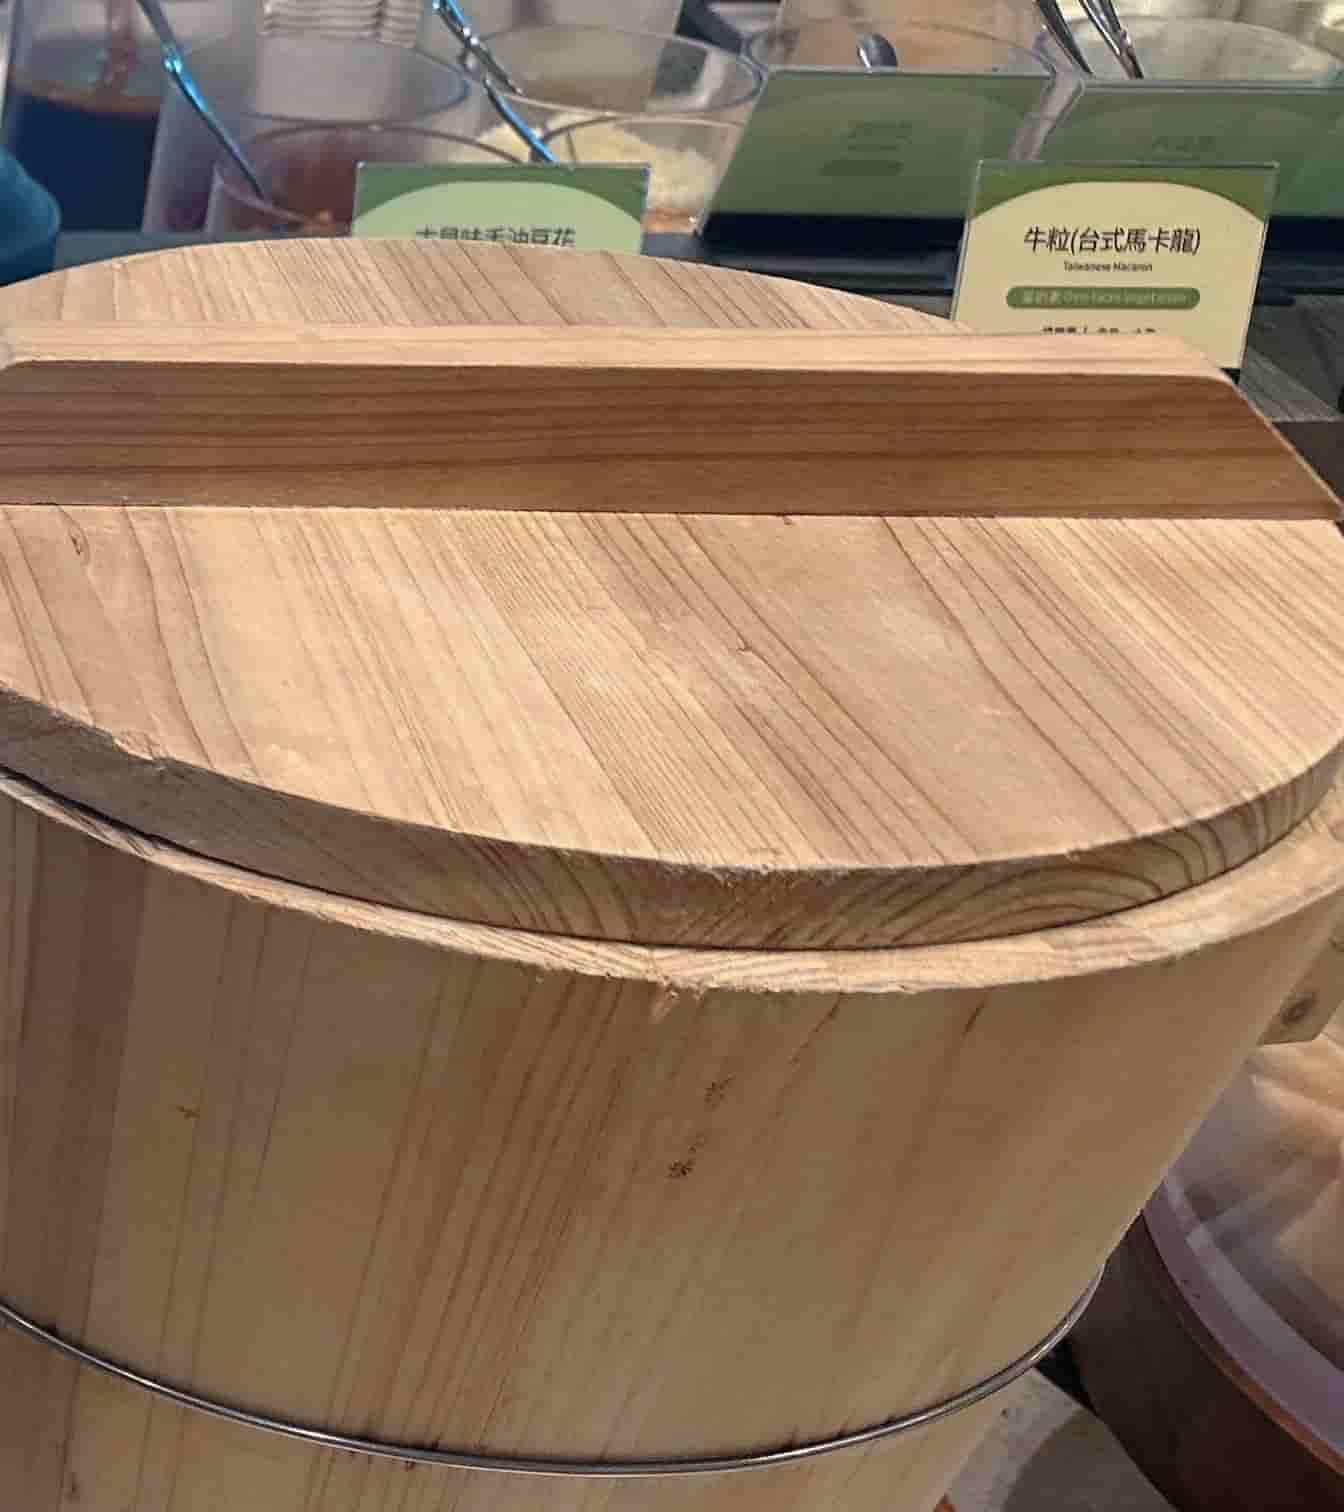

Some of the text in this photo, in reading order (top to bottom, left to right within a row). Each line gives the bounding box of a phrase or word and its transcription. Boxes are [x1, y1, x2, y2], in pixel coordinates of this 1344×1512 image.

[1023, 225, 1201, 255] 牛粒(台式馬卡龍)
